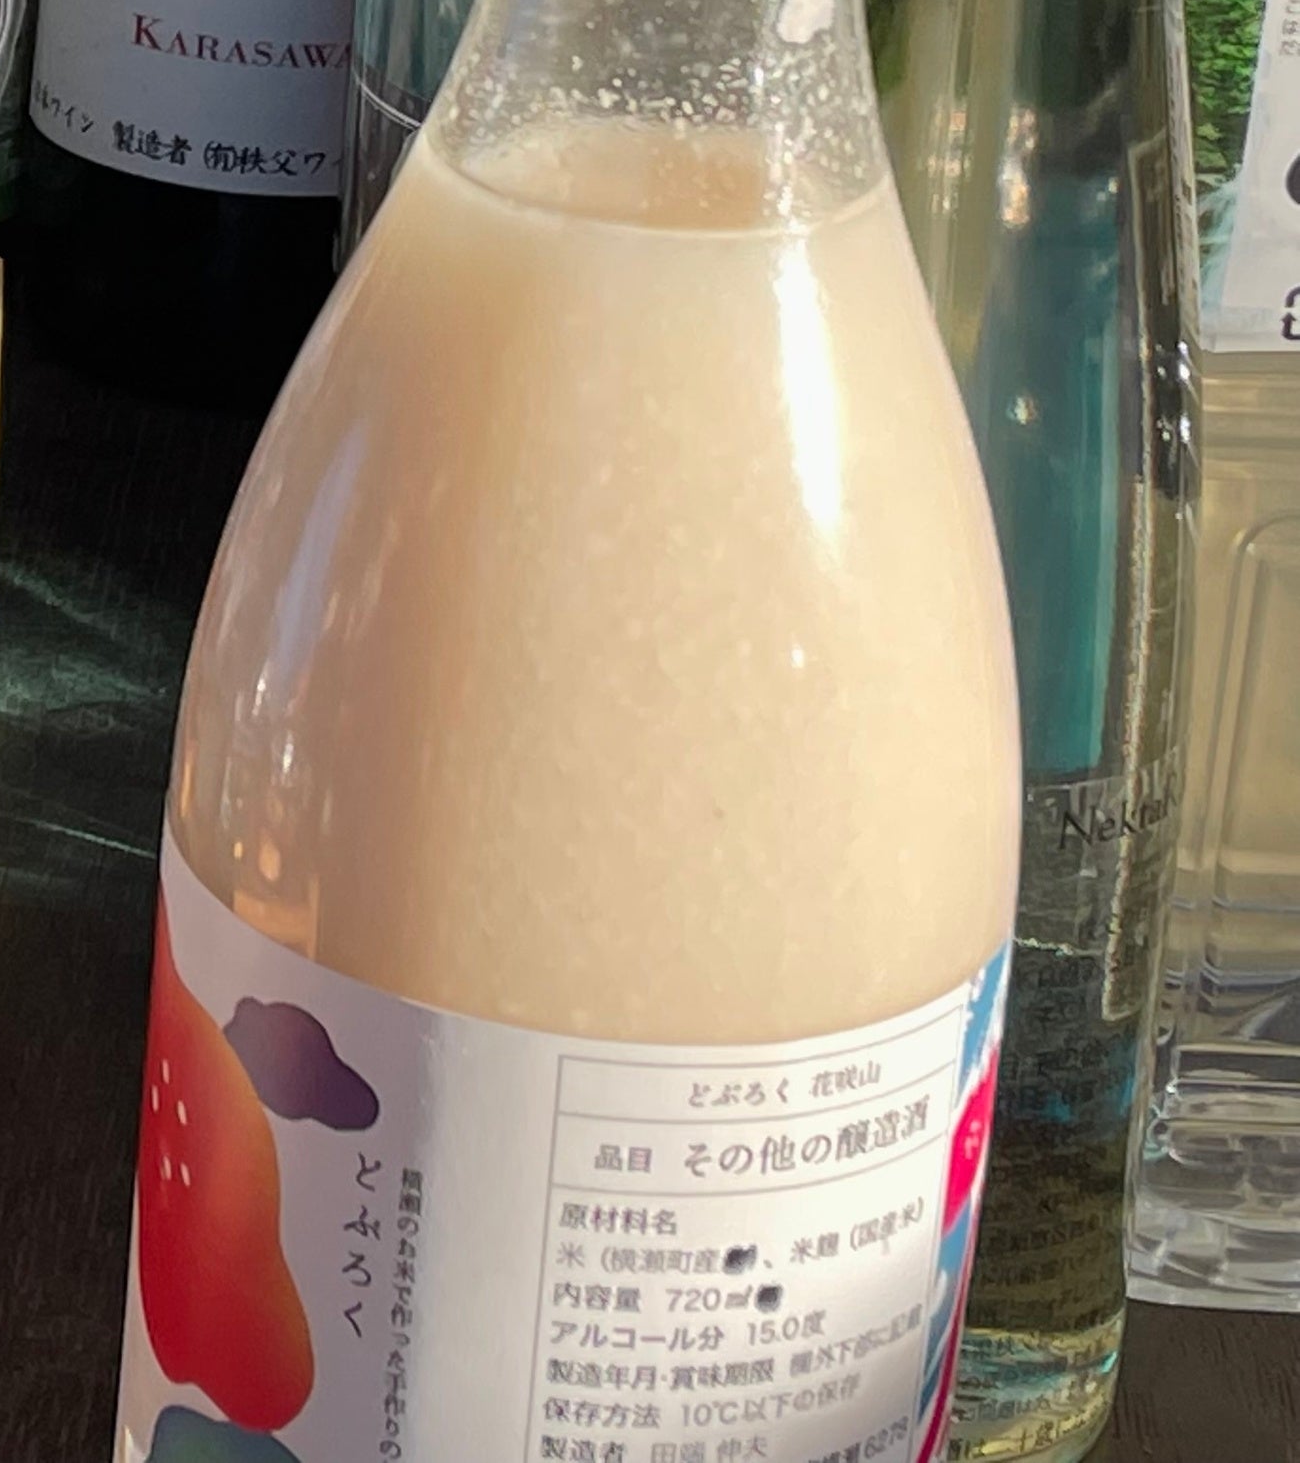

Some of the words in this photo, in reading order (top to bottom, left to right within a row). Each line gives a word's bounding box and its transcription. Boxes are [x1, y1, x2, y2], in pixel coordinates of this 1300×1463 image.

[687, 1079, 789, 1108] どぶろく
[594, 1144, 653, 1173] 品目
[559, 1202, 678, 1236] 原材料名
[553, 1282, 642, 1313] 内容量
[550, 1319, 726, 1352] アルコール分
[747, 1310, 827, 1347] 15.0度
[542, 1395, 662, 1430] 保存方法
